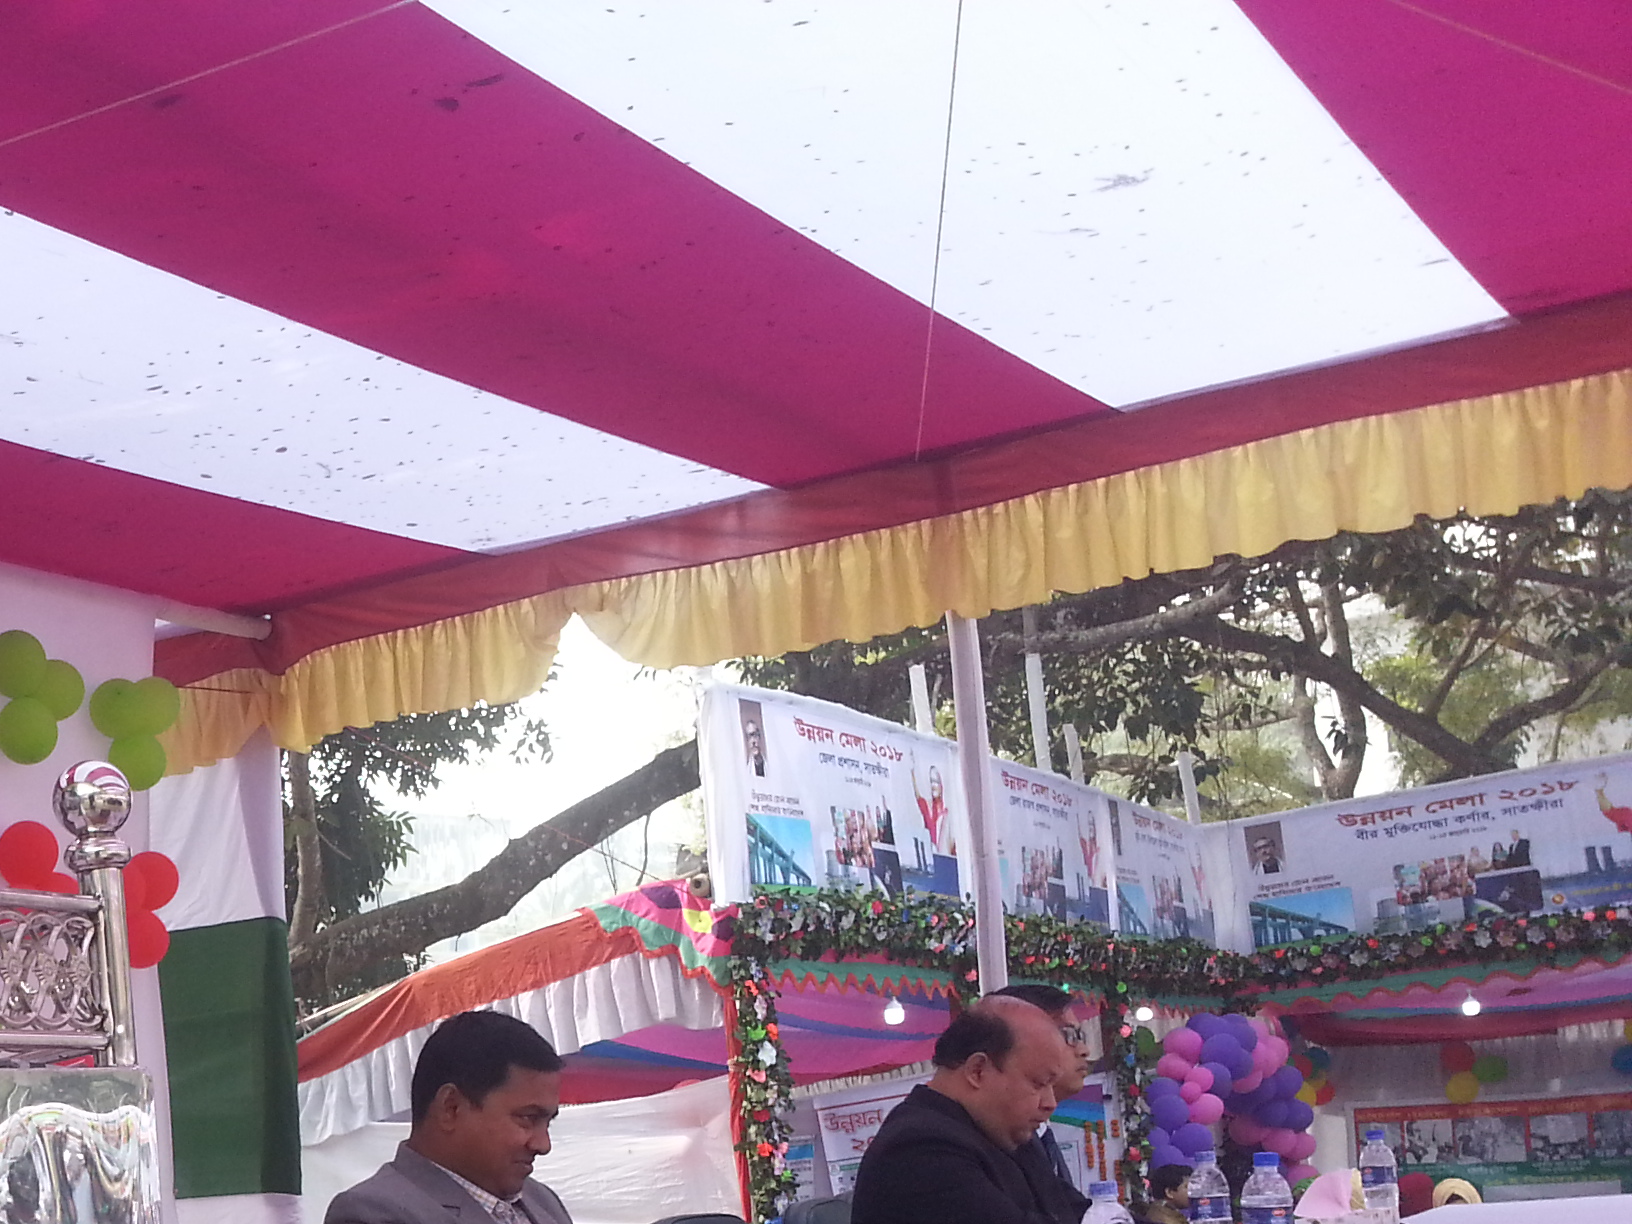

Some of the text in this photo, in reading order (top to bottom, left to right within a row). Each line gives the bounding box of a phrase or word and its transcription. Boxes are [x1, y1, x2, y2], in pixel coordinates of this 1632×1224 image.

[793, 716, 903, 762] উন্নয়ন মেলা ২০১৮
[1336, 780, 1579, 827] উন্নয়ন মেলা ২০১৮
[823, 1109, 883, 1134] উন্নয়ন
